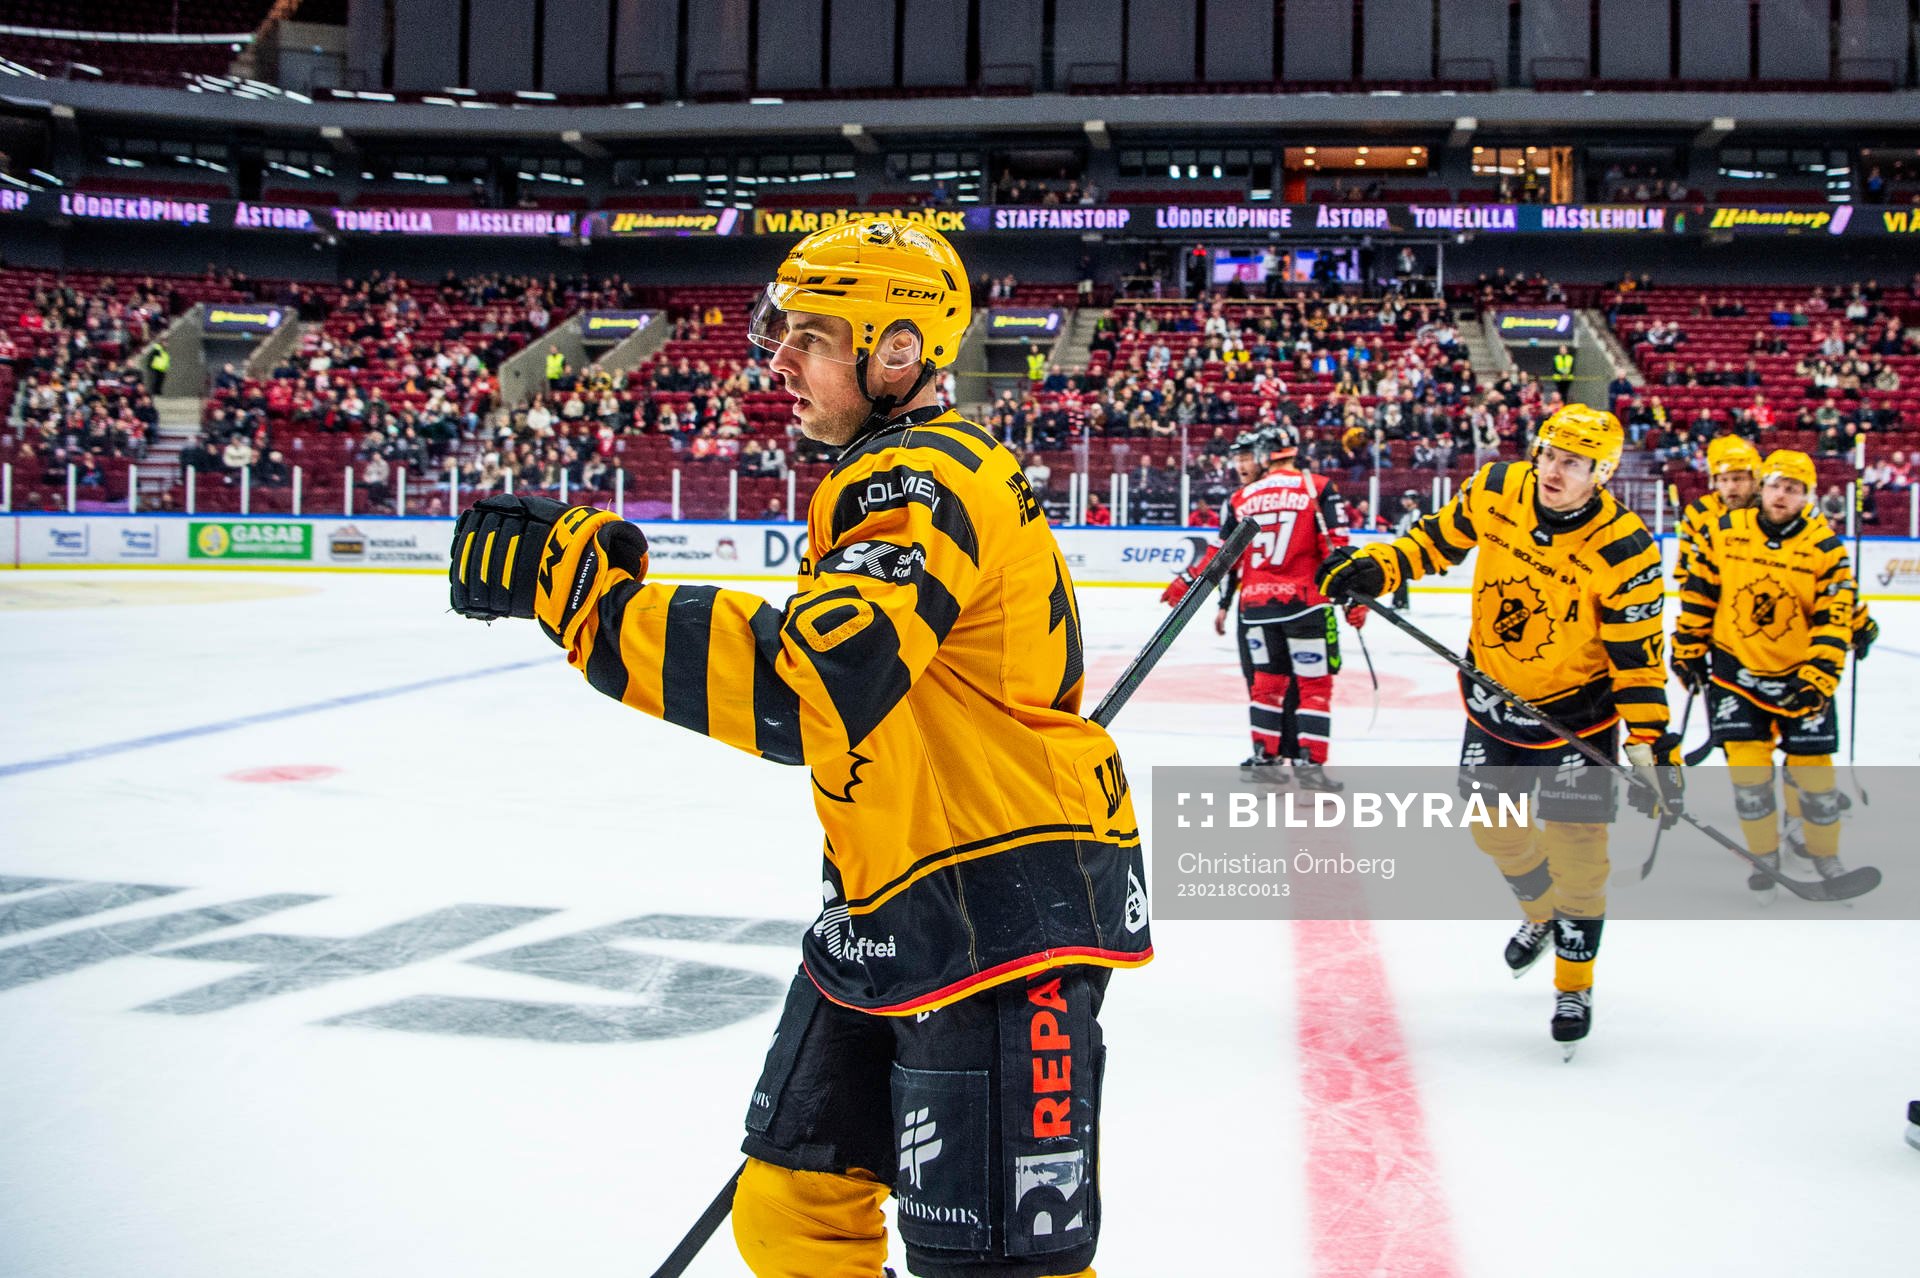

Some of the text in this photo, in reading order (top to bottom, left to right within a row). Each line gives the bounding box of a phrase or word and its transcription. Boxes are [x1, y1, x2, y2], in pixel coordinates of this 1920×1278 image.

[60, 193, 210, 224] LÖDDEKÖPINGE
[235, 202, 312, 228] ÅSTORP
[995, 208, 1131, 229] STAFFANSTORP
[1156, 206, 1292, 229] LÖDDEKÖPINGE
[1316, 204, 1388, 228] ÅSTORP
[1414, 206, 1516, 229] TOMELILLA
[1541, 206, 1664, 229] HÄSSLEHOLM
[335, 210, 433, 232] TOMELILLA
[456, 210, 571, 233] HÄSSLEHOLM
[765, 213, 786, 232] VI
[788, 209, 819, 232] ÄR
[891, 287, 938, 300] CCM
[231, 525, 303, 544] GASAB
[1121, 547, 1186, 563] SUPER
